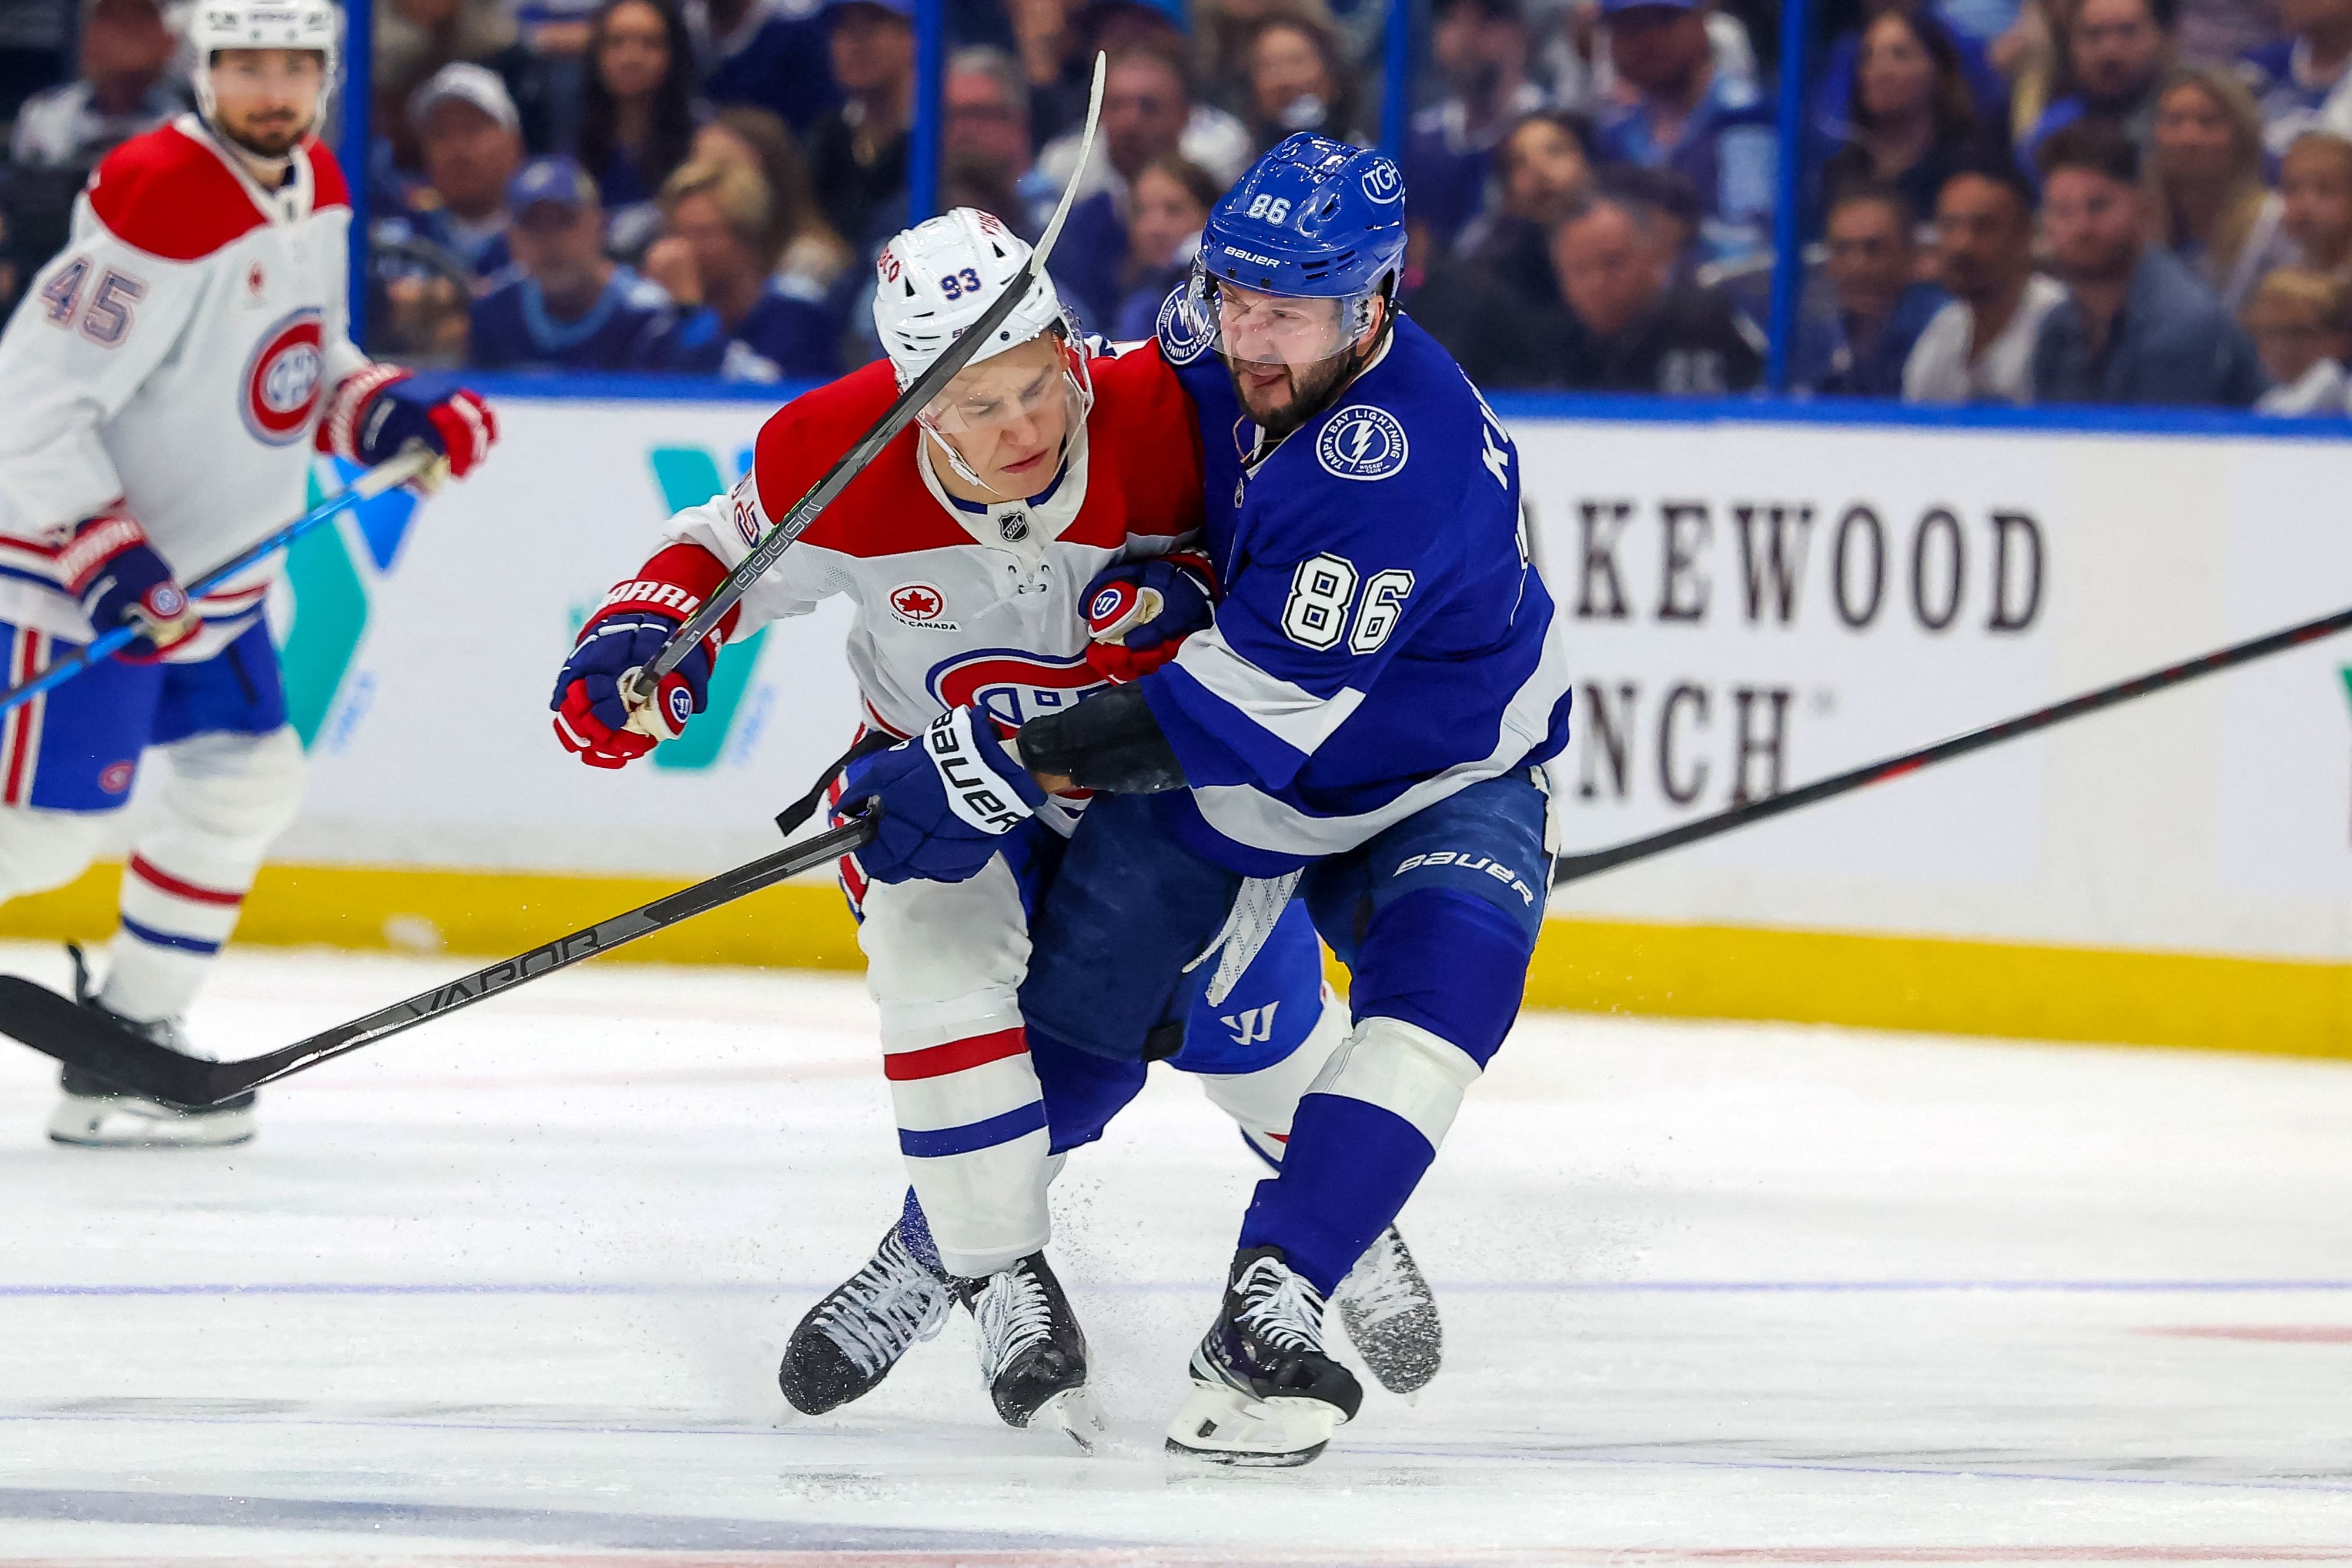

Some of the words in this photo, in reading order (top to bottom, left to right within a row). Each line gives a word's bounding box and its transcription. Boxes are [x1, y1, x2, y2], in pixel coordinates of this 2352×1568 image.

[1245, 193, 1292, 226] 86
[1223, 245, 1281, 268] BAUER
[940, 267, 981, 301] 93
[39, 256, 148, 349] 45
[1328, 413, 1350, 434] BAY
[1355, 410, 1402, 460] LIGHTNING
[1323, 436, 1344, 470] TAMPA
[1359, 461, 1384, 470] HOCKEY
[1006, 519, 1023, 538] NHL
[1576, 501, 2045, 634] KEWOOD
[601, 580, 701, 614] ARRI
[1280, 551, 1416, 656] 86
[908, 621, 957, 630] CANADA
[1578, 680, 1795, 816] NCH
[931, 707, 1029, 833] BAUER
[1392, 851, 1534, 907] BAUER
[406, 927, 599, 1017] VAPOR
